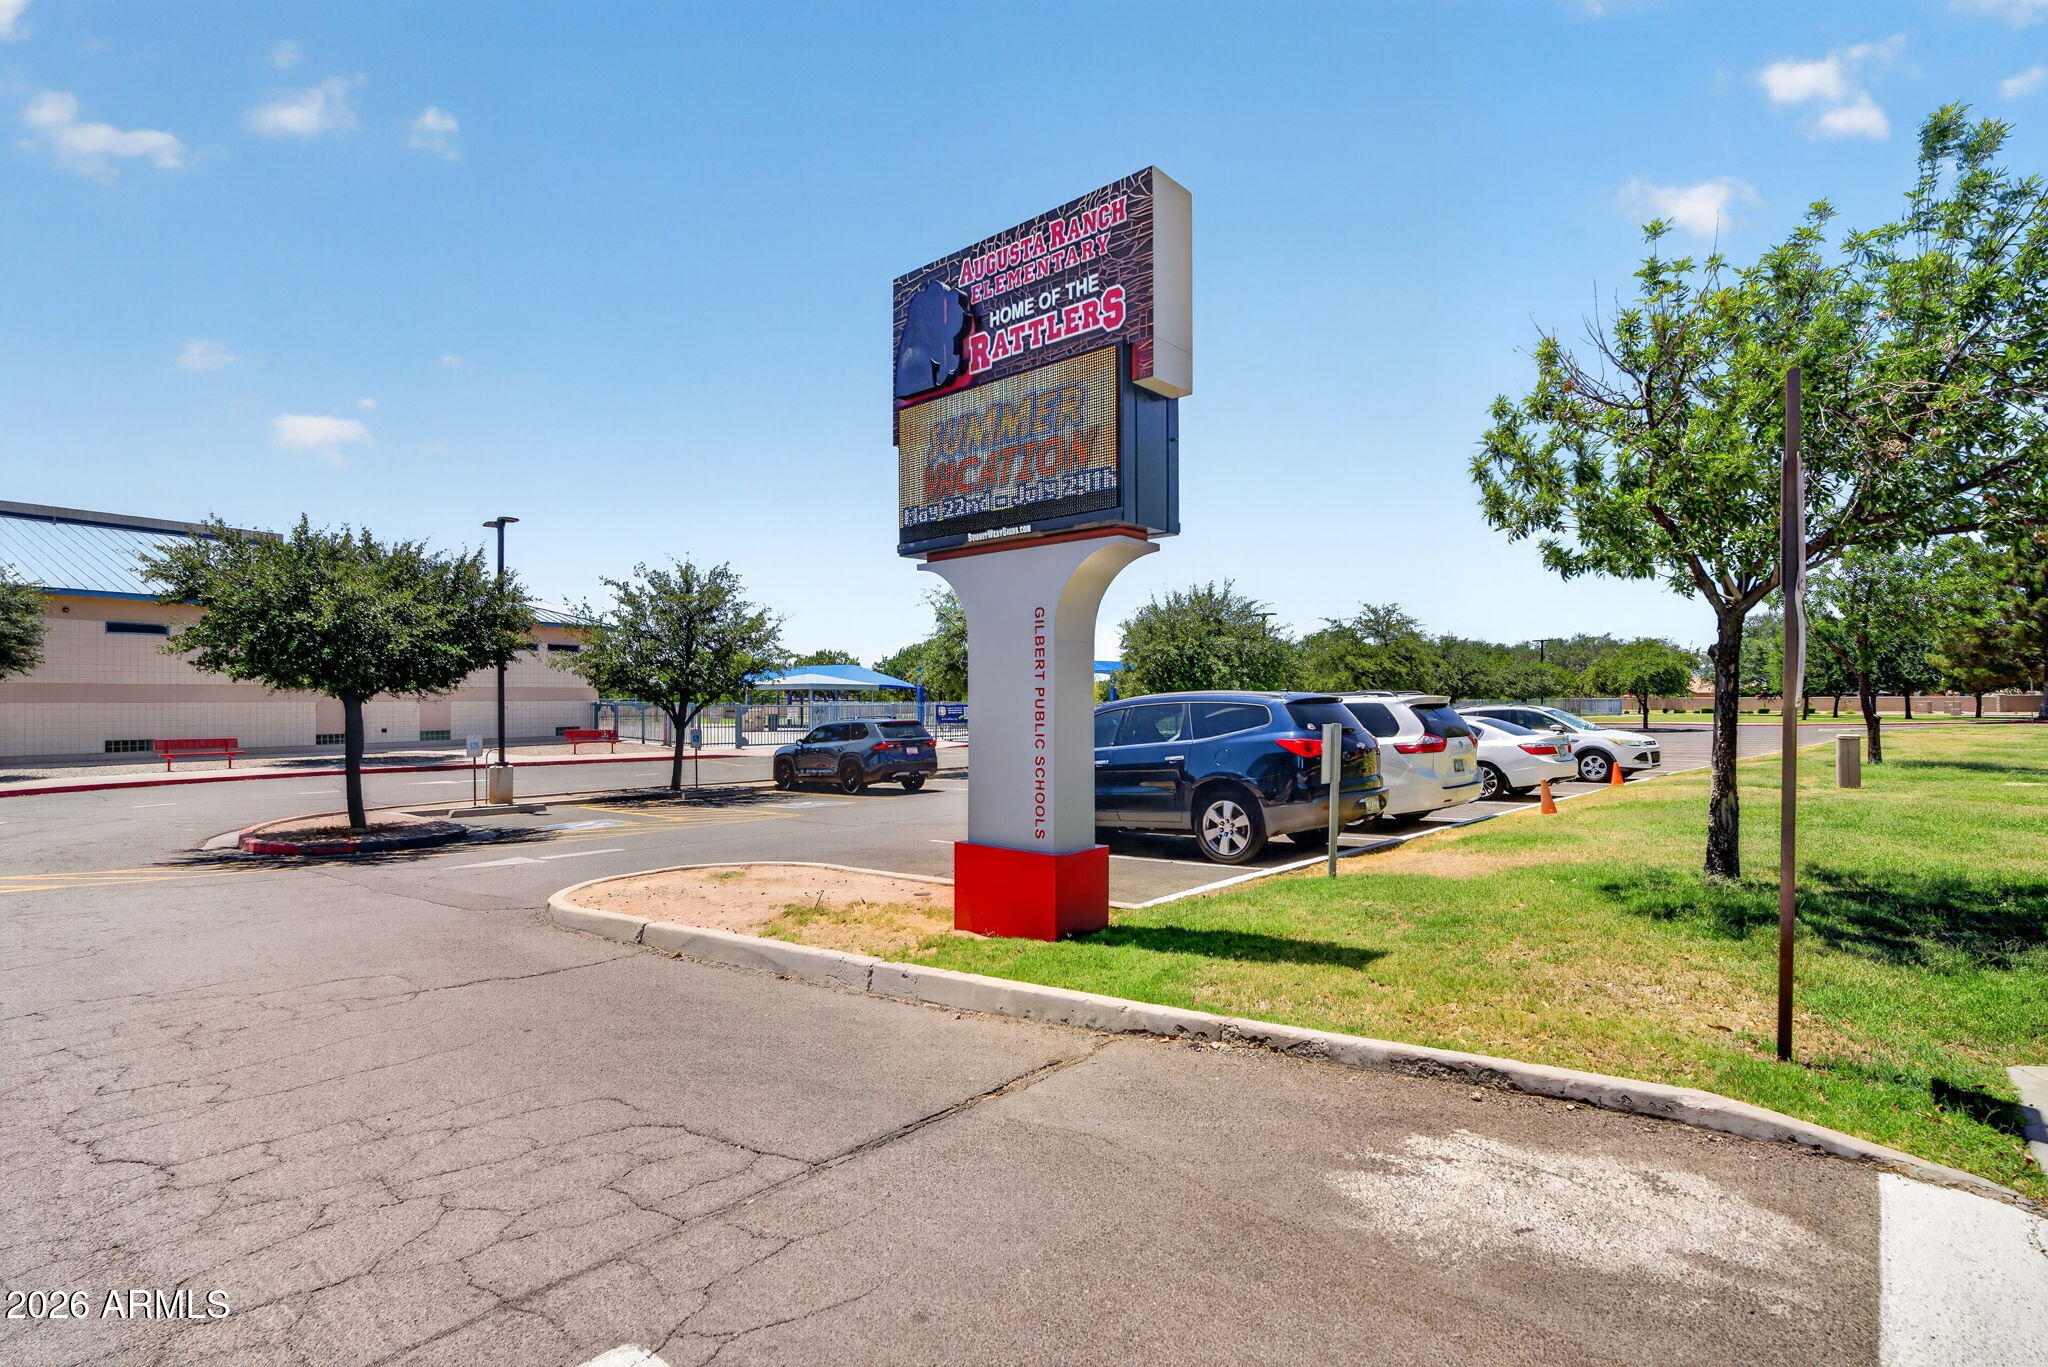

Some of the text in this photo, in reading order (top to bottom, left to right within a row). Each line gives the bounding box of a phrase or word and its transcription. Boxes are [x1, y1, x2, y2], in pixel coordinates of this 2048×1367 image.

[958, 195, 1128, 288] AUGUSTA RANCH
[970, 231, 1111, 305] ELEMENTARY
[968, 284, 1126, 375] RATTLERS
[989, 273, 1100, 328] HOME OF THE
[928, 383, 1086, 458] SUMMER
[924, 429, 1100, 501] VACATION
[903, 506, 938, 526] May
[943, 494, 990, 518] 22nd
[1034, 606, 1046, 839] GILBERT PUBLIC SCHOOLS
